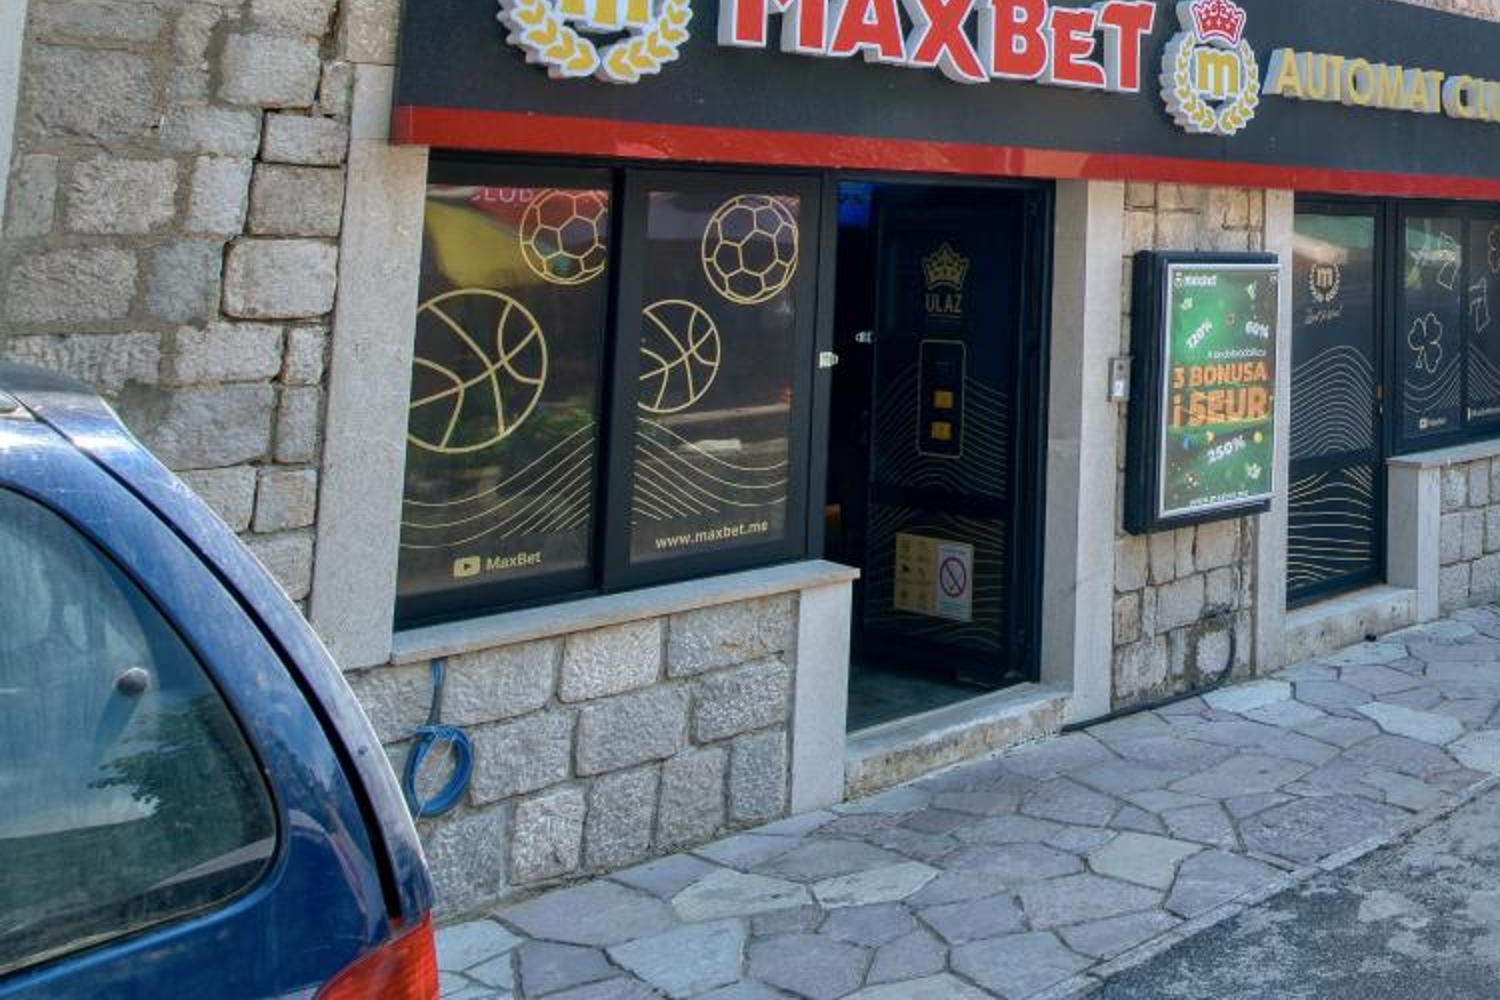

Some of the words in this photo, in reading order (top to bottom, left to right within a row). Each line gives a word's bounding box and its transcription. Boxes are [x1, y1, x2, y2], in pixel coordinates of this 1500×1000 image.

[1263, 47, 1446, 114] AUTOMAT
[1189, 361, 1267, 387] BONUSA
[654, 519, 769, 550] www.maxbet.me
[485, 550, 542, 572] MaxBet
